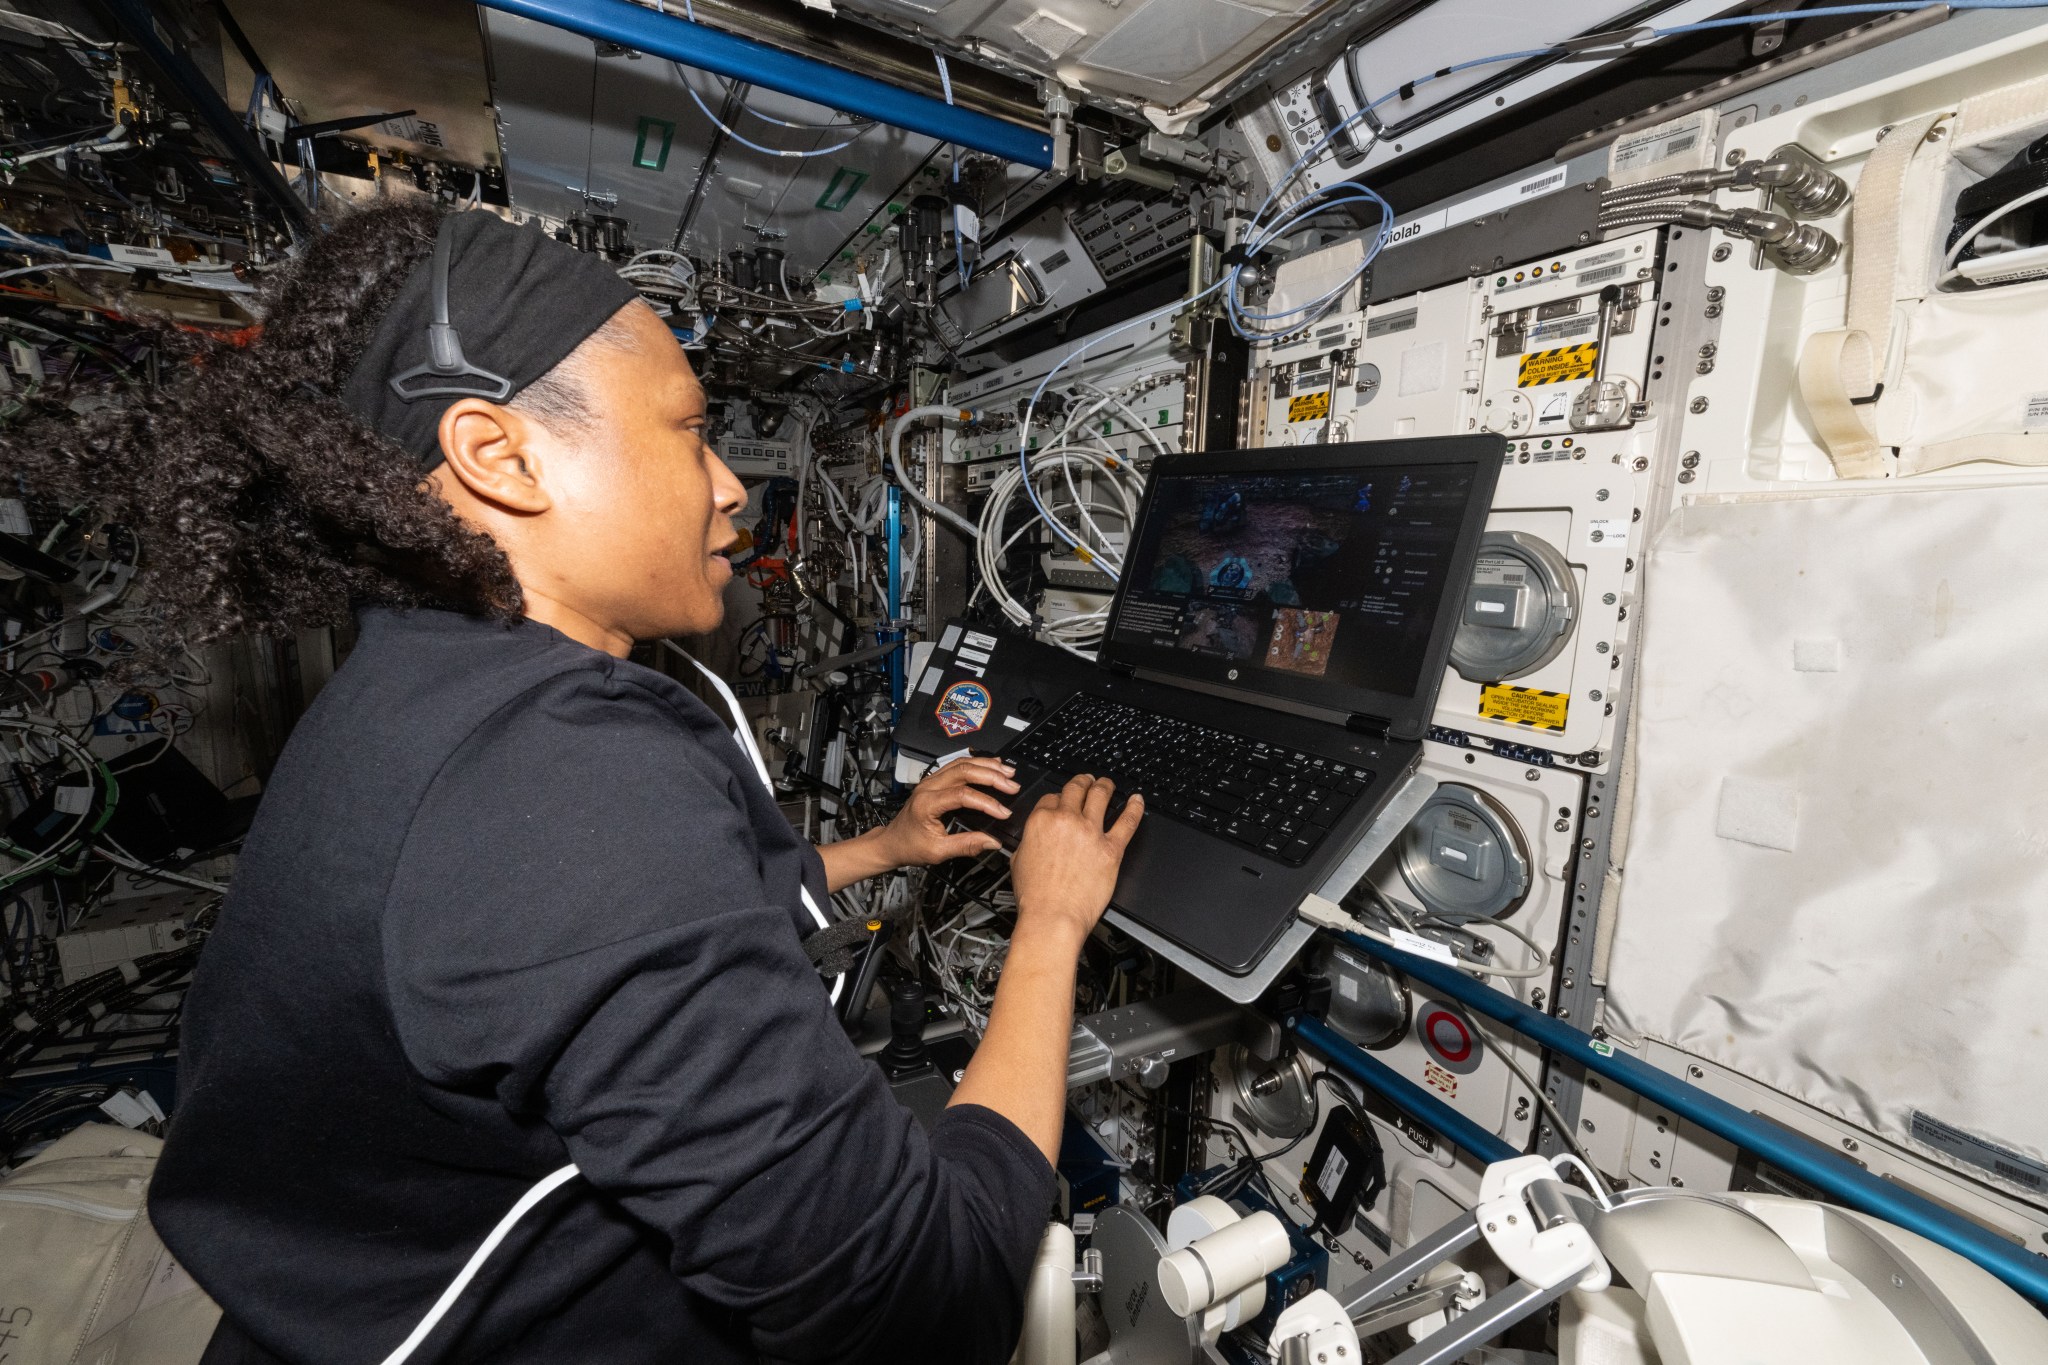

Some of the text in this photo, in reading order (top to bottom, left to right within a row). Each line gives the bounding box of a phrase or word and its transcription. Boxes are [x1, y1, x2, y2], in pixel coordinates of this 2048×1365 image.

[1641, 134, 1654, 143] Right
[1654, 131, 1669, 140] Nylon
[1669, 126, 1683, 135] Cover
[1548, 322, 1563, 331] Temp
[1528, 355, 1563, 367] WARNING
[1527, 362, 1569, 375] COLD INSIDE
[1294, 399, 1314, 407] WARNING
[950, 692, 984, 709] AMS-02
[1505, 696, 1535, 706] INCUBATOR
[1535, 701, 1558, 710] SEALING
[1511, 692, 1538, 701] CAUTION
[1486, 708, 1517, 717] EXTRACTION
[1535, 716, 1560, 725] DRAWER
[1501, 705, 1544, 717] VOLUME BEFORE
[1529, 705, 1555, 714] WORKING
[1408, 1126, 1429, 1148] PUSH
[1937, 1120, 1971, 1140] Glovebox
[1972, 1135, 1995, 1151] Nylon
[1995, 1145, 2020, 1159] Cover
[1126, 1288, 1138, 1313] force
[1130, 1281, 1149, 1328] dimension
